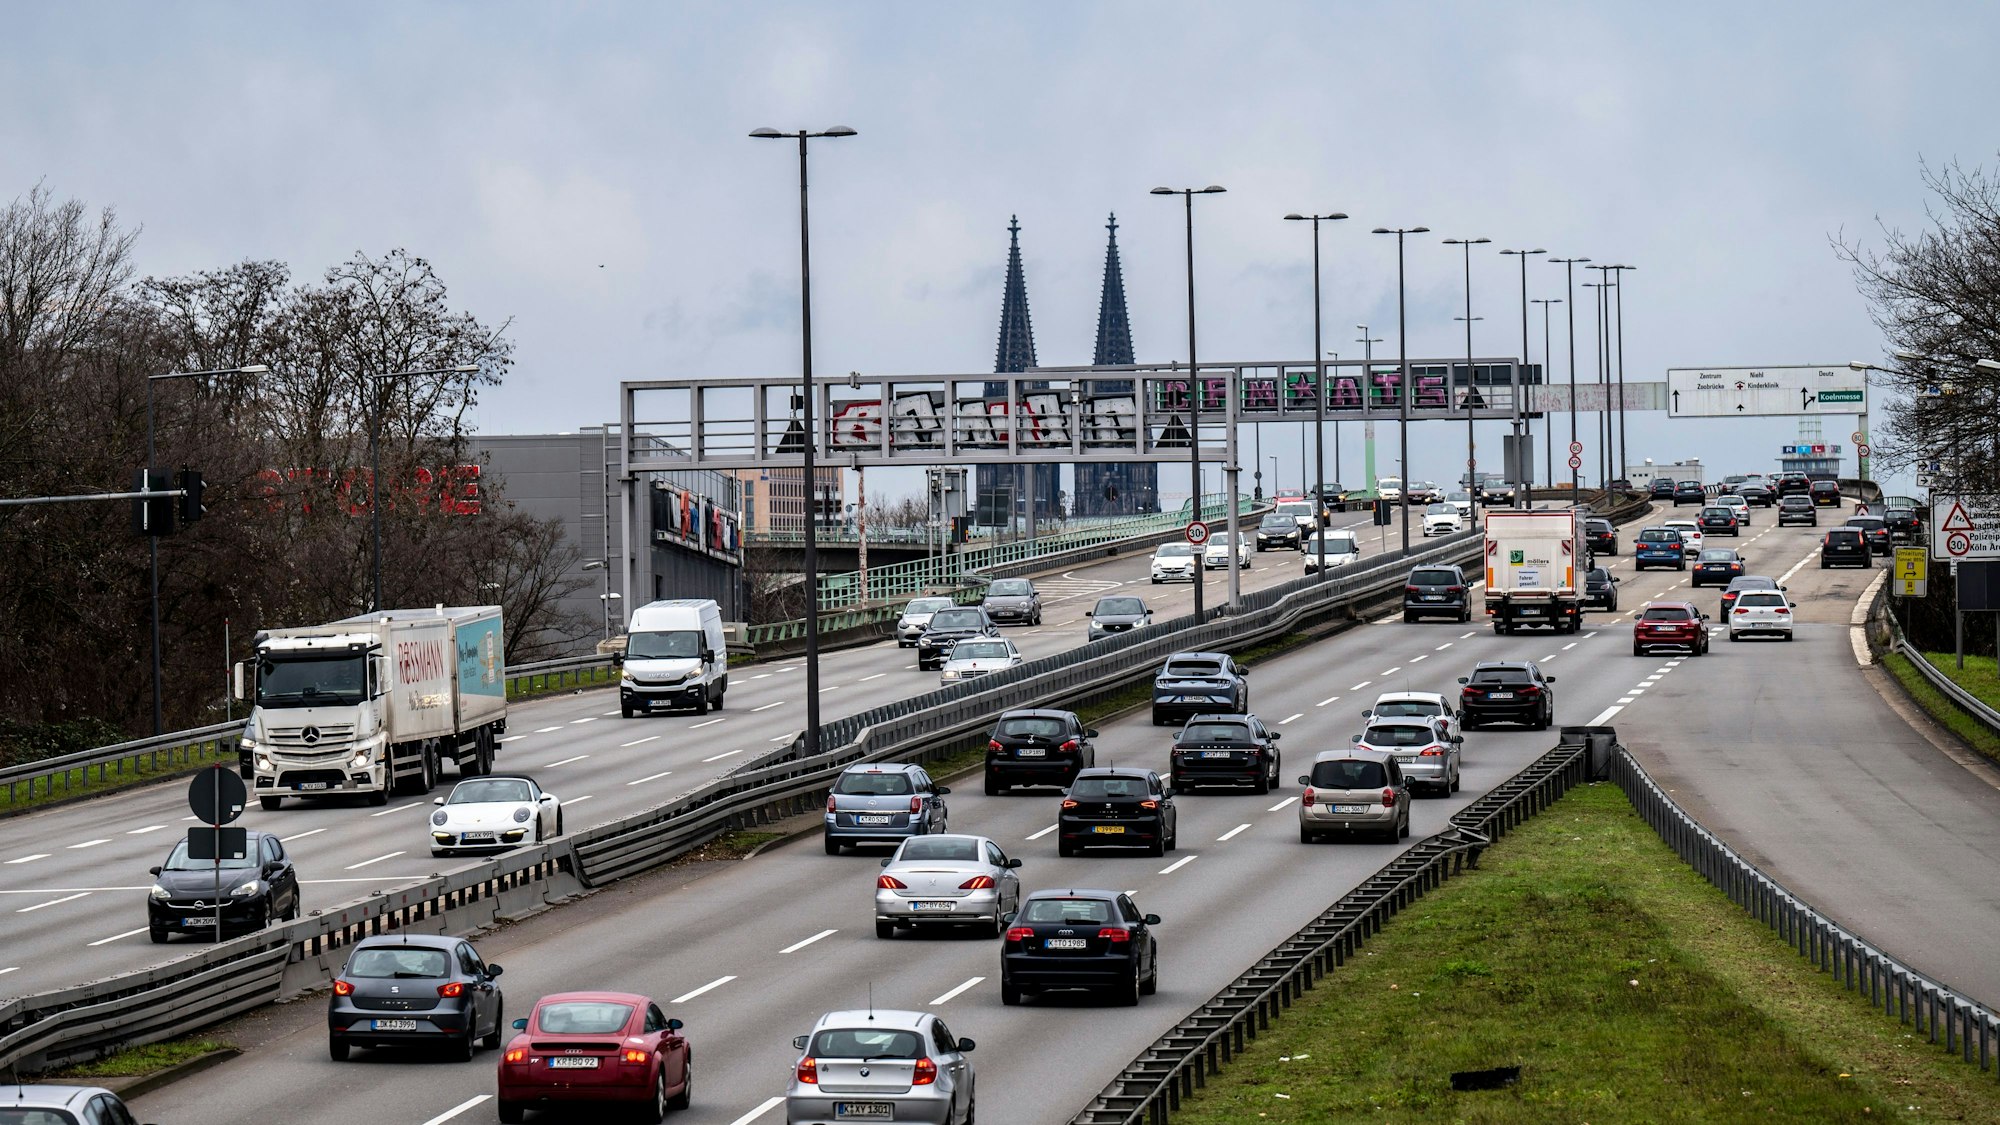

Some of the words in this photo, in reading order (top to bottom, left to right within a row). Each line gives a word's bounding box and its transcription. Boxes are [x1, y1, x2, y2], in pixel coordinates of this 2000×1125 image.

[1820, 393, 1861, 401] Koelnmesse
[1190, 528, 1204, 538] 30t
[1950, 540, 1966, 550] 30t
